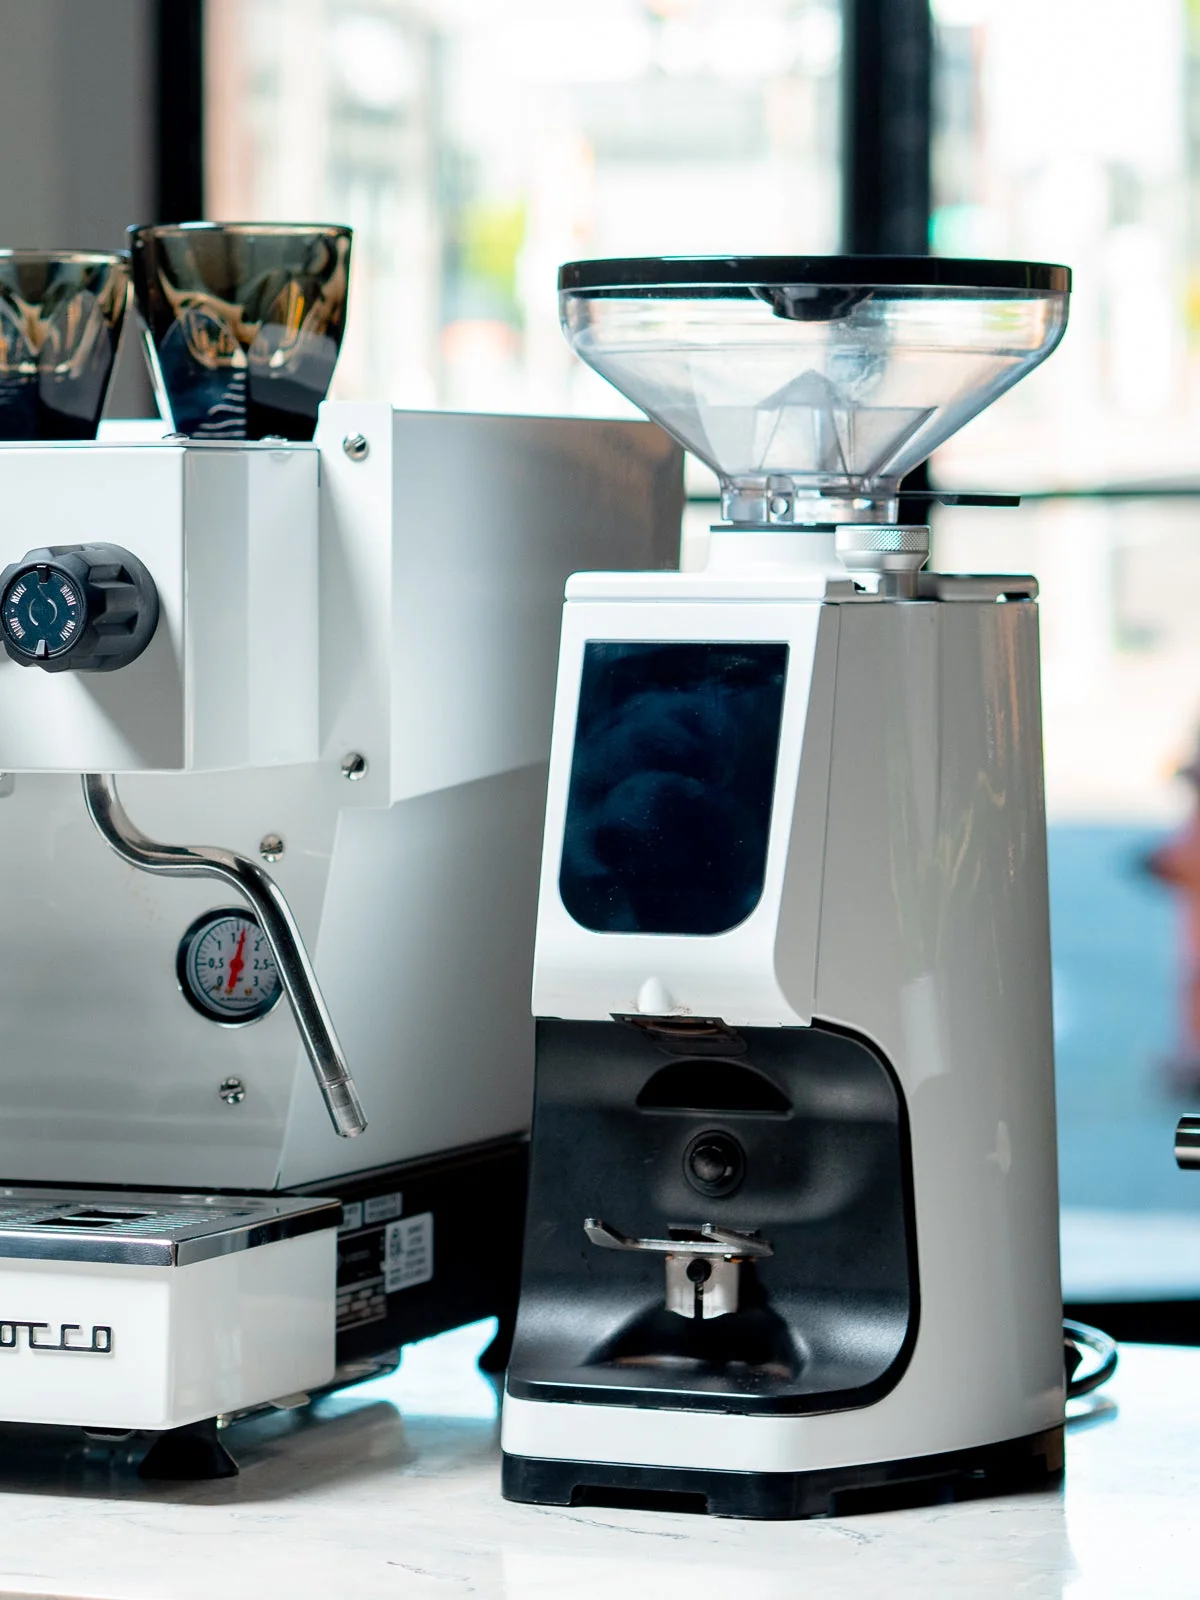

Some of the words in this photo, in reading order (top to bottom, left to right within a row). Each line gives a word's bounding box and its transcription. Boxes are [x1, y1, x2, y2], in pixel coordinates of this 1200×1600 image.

[10, 583, 27, 604] MINI
[59, 584, 77, 606] MINI
[9, 617, 26, 639] MINI
[59, 620, 76, 641] MINI
[217, 940, 221, 951] 1
[254, 940, 260, 952] 2
[216, 975, 223, 986] 0
[253, 976, 258, 986] 3
